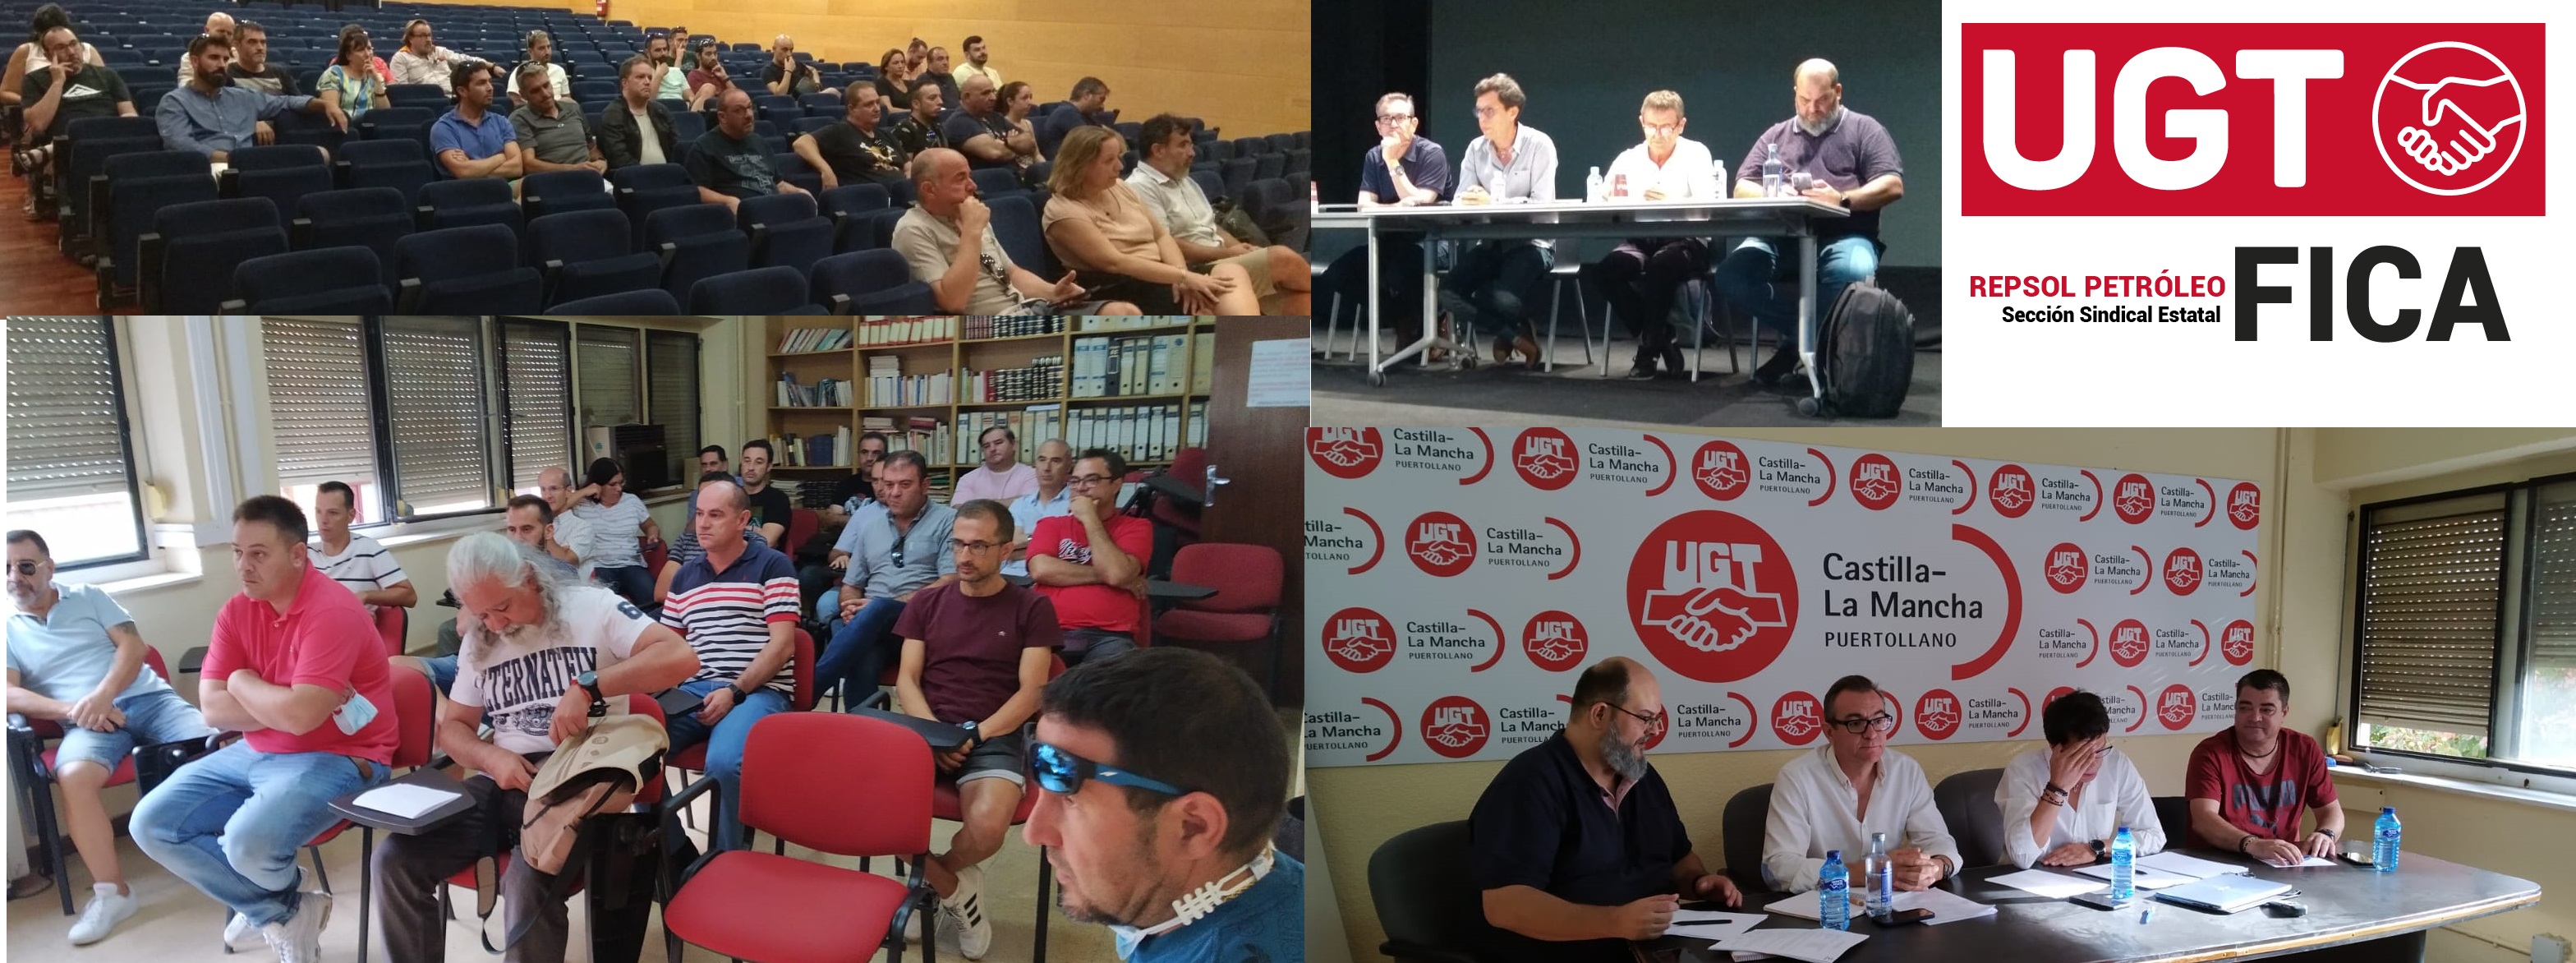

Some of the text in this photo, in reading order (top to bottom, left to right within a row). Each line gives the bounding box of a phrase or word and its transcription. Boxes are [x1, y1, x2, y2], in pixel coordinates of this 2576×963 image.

[1322, 427, 1366, 443] UGT
[1394, 428, 1453, 445] Castilla-
[1395, 443, 1473, 459] La Mancha
[1525, 436, 1564, 457] UGT
[1589, 444, 1641, 458] Castilla-
[1396, 461, 1460, 471] PUERTOLLANO
[1590, 458, 1658, 472] La Mancha
[1704, 450, 1737, 469] UGT
[1760, 457, 1806, 472] Castilla-
[1590, 473, 1647, 483] PUERTOLLANO
[1760, 470, 1819, 483] La Mancha
[1860, 463, 1890, 480] UGT
[1909, 468, 1950, 482] Castilla-
[1910, 481, 1962, 493] La Mancha
[1999, 473, 2026, 491] UGT
[2042, 478, 2078, 491] Castilla-
[1760, 485, 1810, 494] PUERTOLLANO
[2042, 490, 2090, 501] La Mancha
[2122, 482, 2146, 498] UGT
[2161, 486, 2194, 499] Castilla-
[2161, 498, 2204, 508] La Mancha
[2234, 491, 2256, 505] UGT
[1304, 520, 1341, 532] tilla-
[1419, 523, 1461, 542] UGT
[1487, 528, 1543, 540] Castilla-
[1488, 542, 1562, 555] La Mancha
[1304, 552, 1350, 560] TOLLANO
[2054, 551, 2079, 567] UGT
[2095, 555, 2130, 564] Castilla-
[1488, 559, 1549, 567] PUERTOLLANO
[1663, 540, 1763, 593] UGT
[1824, 553, 1946, 583] Castilla-
[2172, 556, 2195, 571] UGT
[2209, 559, 2240, 567] Castilla-
[2095, 566, 2140, 575] La Mancha
[2209, 569, 2249, 578] La Mancha
[618, 601, 642, 620] 6
[1825, 590, 1982, 618] La Mancha
[1337, 619, 1379, 639] UGT
[1407, 622, 1465, 633] Castilla-
[1536, 621, 1574, 639] UGT
[2040, 629, 2075, 638] Castilla-
[1825, 632, 1956, 647] PUERTOLLANO
[2118, 628, 2142, 642] UGT
[2229, 628, 2251, 642] UGT
[1408, 637, 1484, 647] La Mancha
[2040, 640, 2086, 648] La Mancha
[1969, 698, 2006, 707] Castilla-
[2165, 692, 2188, 706] UGT
[2202, 693, 2235, 703] Castilla-
[1500, 707, 1554, 718] Castilla-
[1677, 704, 1725, 714] Castilla-
[1782, 701, 1813, 717] UGT
[1925, 698, 1952, 715] UGT
[1434, 707, 1474, 726] UGT
[1969, 709, 2017, 719] La Mancha
[1502, 721, 1565, 731] La Manch
[1678, 716, 1741, 727] La Mancha
[1322, 726, 1380, 737] Mancha
